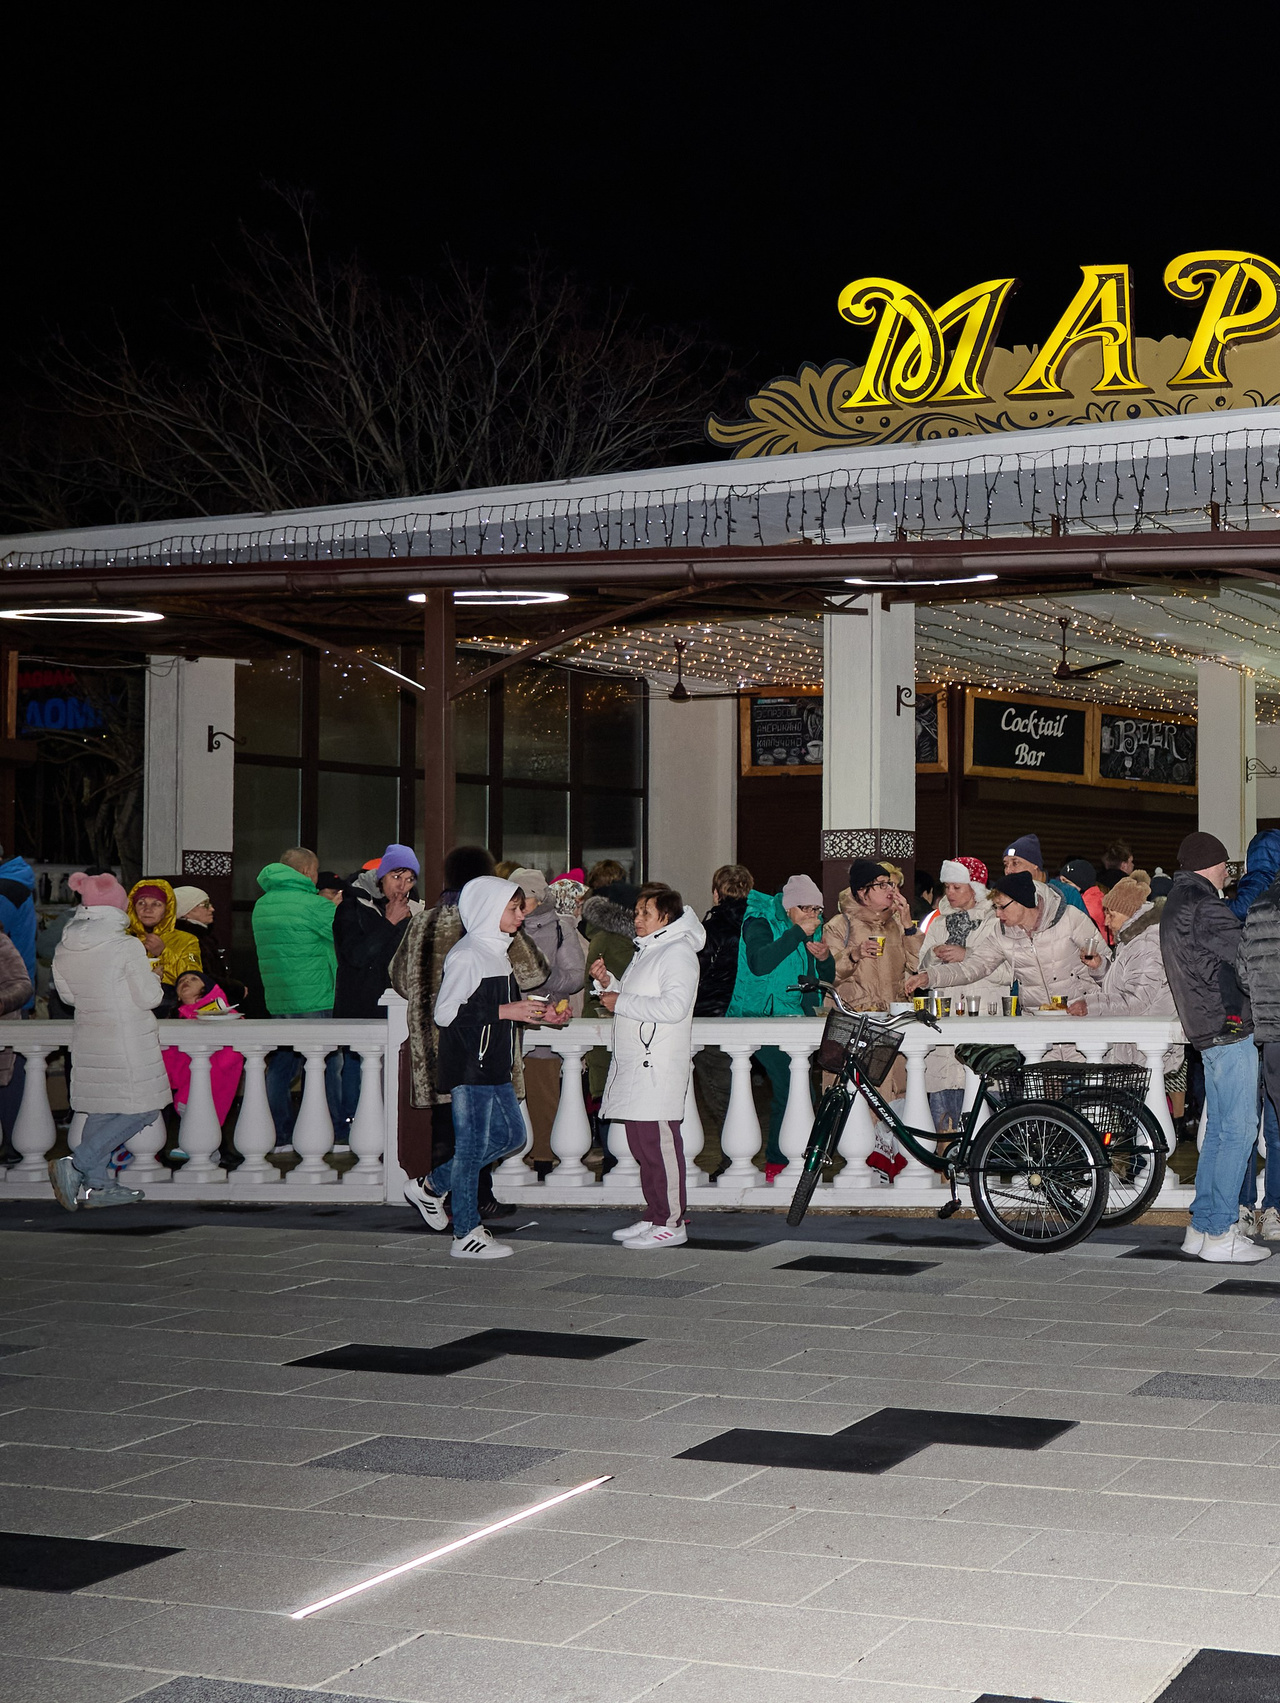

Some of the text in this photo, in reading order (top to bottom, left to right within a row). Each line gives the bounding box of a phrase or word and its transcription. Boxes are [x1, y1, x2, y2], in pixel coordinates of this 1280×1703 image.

[756, 721, 803, 734] АМЕРИКАНО
[1000, 706, 1069, 740] Cocktail
[756, 737, 803, 748] КАППУЧИНО
[1014, 742, 1047, 767] Bar
[1114, 719, 1188, 762] BEER
[860, 1083, 881, 1107] ТРАЙК
[878, 1107, 897, 1128] БАЙК
